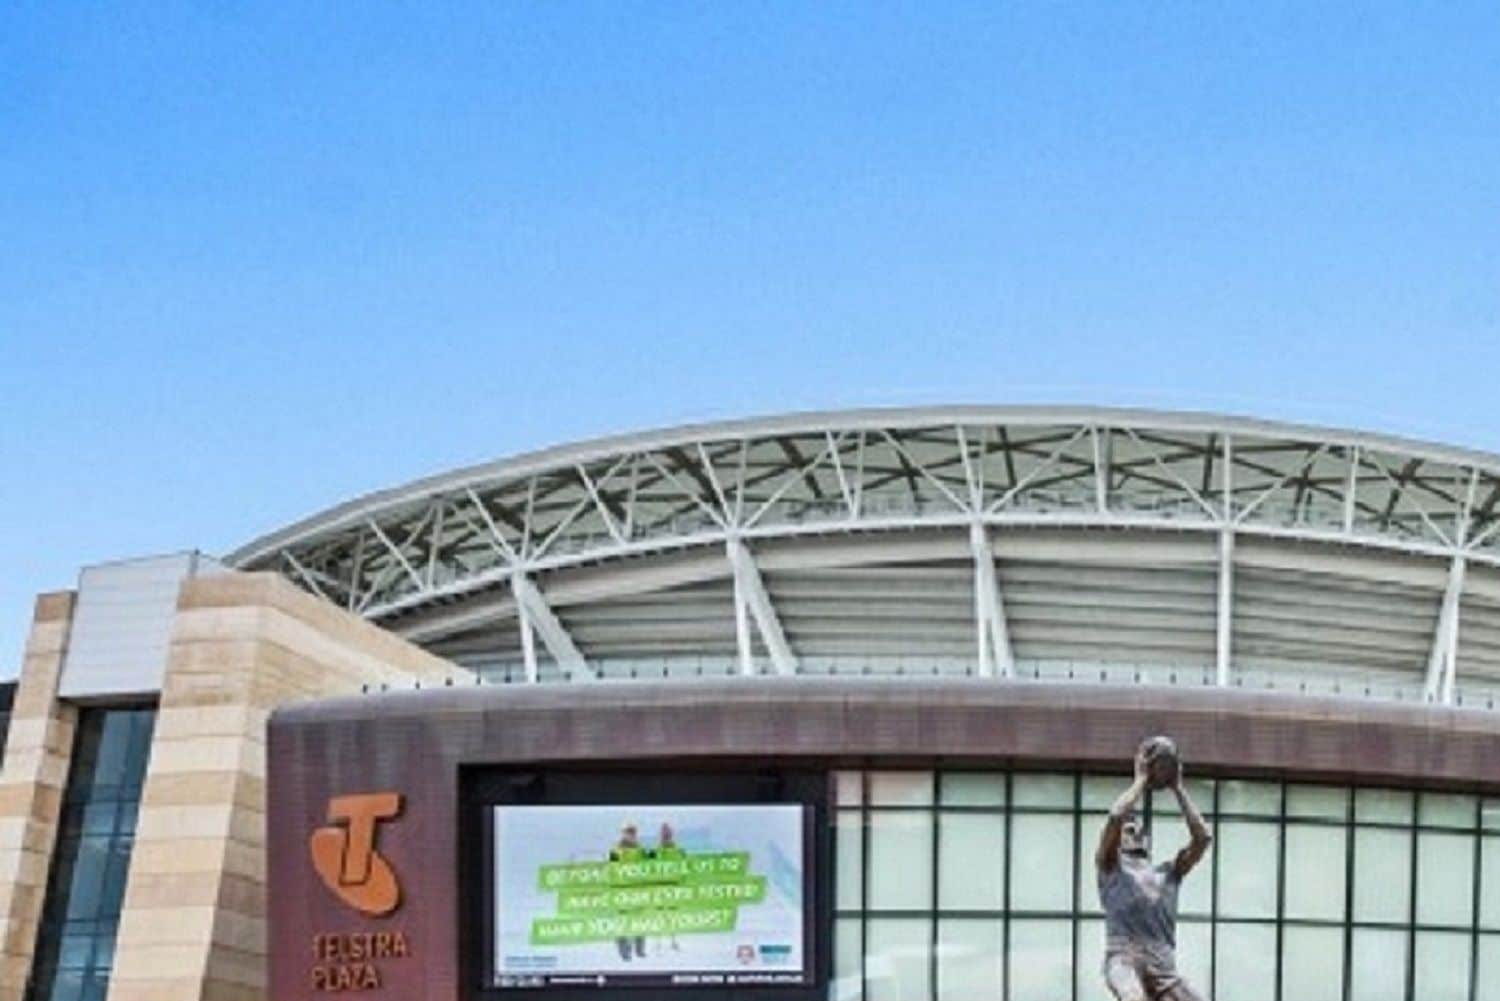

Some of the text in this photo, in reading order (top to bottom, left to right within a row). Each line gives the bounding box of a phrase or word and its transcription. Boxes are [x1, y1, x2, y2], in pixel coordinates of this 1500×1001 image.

[617, 861, 651, 878] YOU
[313, 931, 410, 960] TELSTRA
[312, 961, 382, 991] PLAZA
